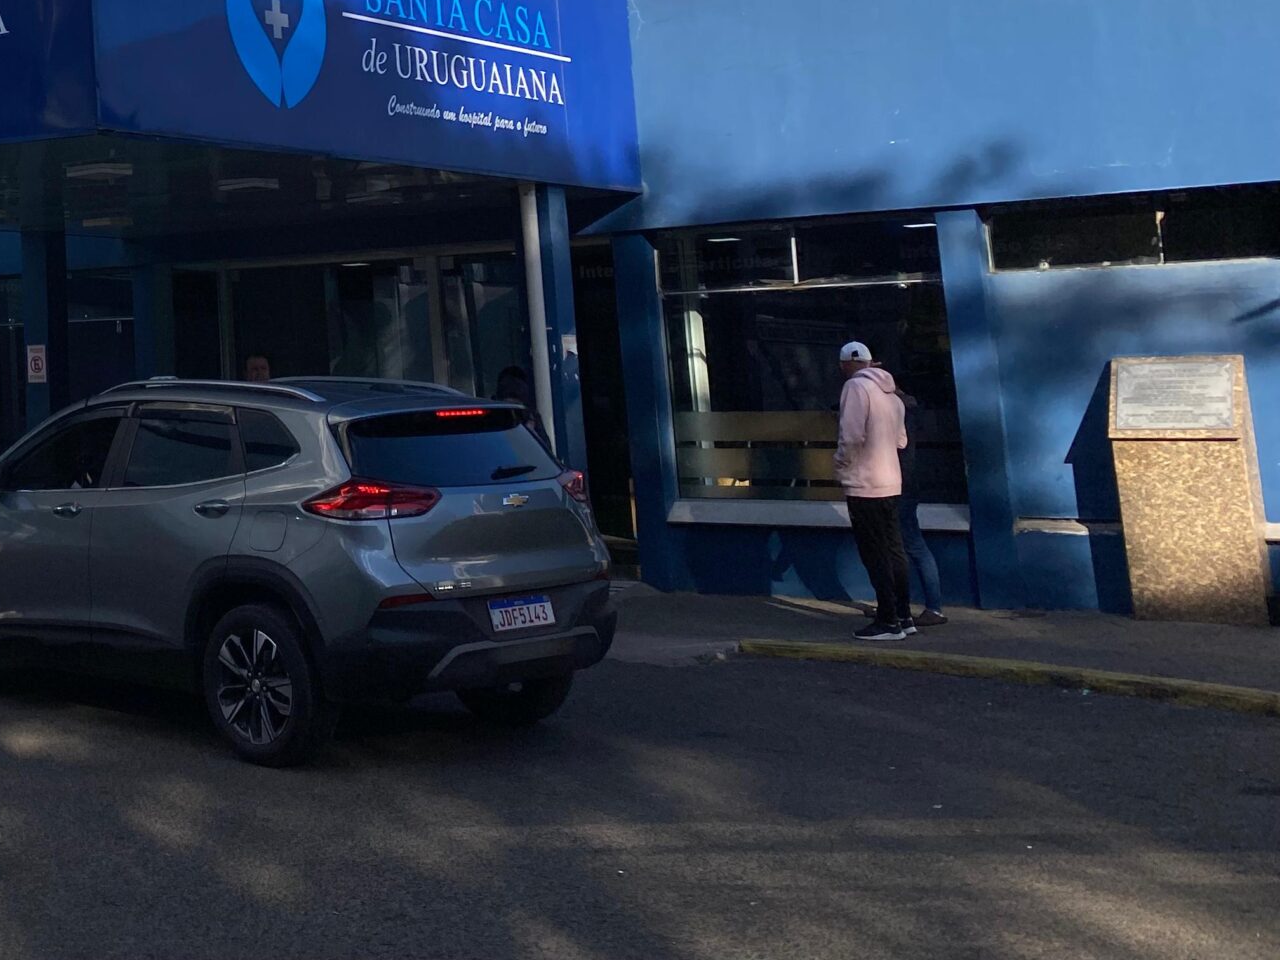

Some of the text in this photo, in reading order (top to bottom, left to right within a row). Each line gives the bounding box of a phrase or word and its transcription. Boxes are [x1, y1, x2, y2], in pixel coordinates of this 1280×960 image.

[362, 38, 564, 105] de URUGUAIANA
[387, 94, 547, 137] Construindo um hospital para o futuro
